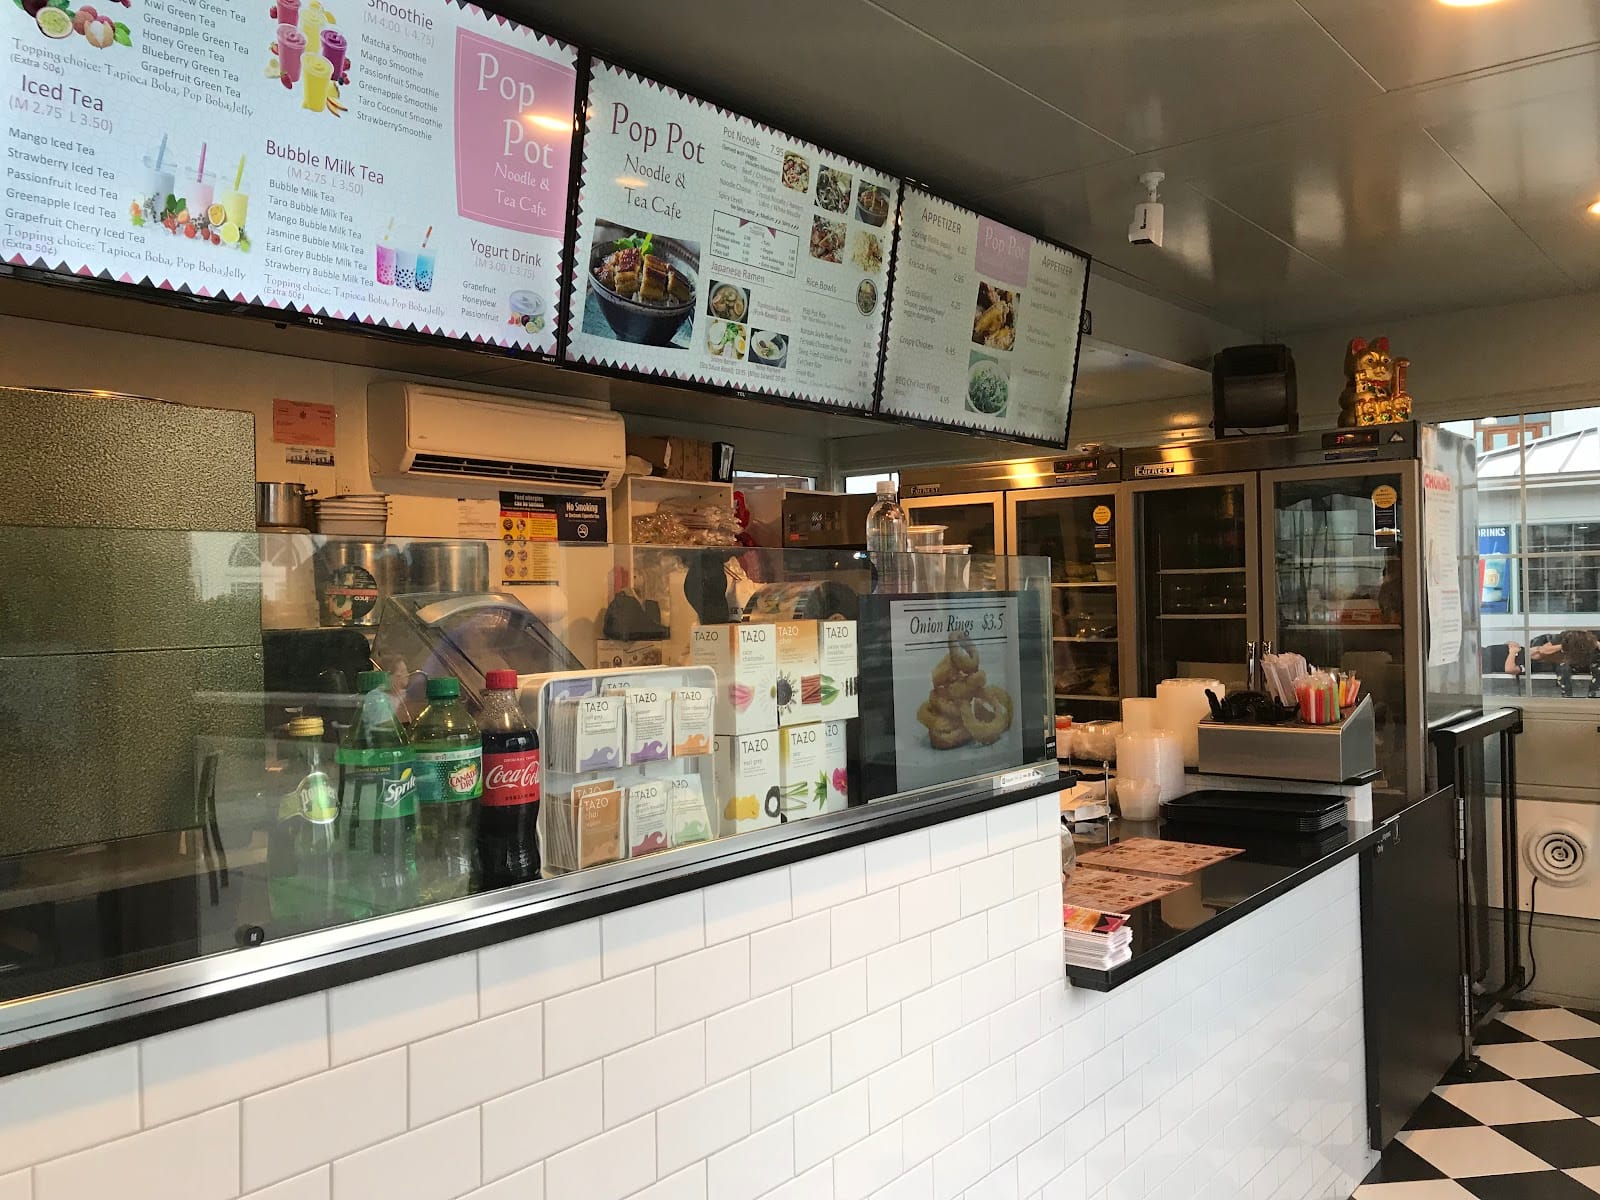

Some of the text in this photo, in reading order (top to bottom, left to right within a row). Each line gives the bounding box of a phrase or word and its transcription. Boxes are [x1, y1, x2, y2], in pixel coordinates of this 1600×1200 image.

[167, 4, 196, 21] Green
[199, 14, 216, 28] Tea
[199, 0, 246, 23] Green Tea
[142, 28, 225, 63] Honey Green Tea
[143, 13, 249, 55] Greenapple Green Tea
[142, 44, 239, 82] Blueberry Green Tea
[361, 33, 427, 65] Matcha Smoothie
[12, 37, 60, 63] Topping
[104, 63, 147, 86] Tapioca
[183, 87, 202, 103] Pop
[360, 49, 424, 79] Mango Smoothie
[22, 74, 103, 112] Iced Tea
[141, 60, 241, 98] Grapefruit Green Tea
[359, 64, 440, 99] Passionfruit Smoothie
[477, 52, 535, 113] Pop
[358, 80, 438, 113] Greenapple Smoothie
[358, 95, 443, 130] Taro Coconut Smoothie
[9, 127, 95, 156] Mango Iced Tea
[503, 119, 553, 169] Pot
[611, 102, 657, 153] Pop
[666, 122, 705, 164] Pot
[8, 147, 115, 180] Strawberry Iced Tea
[266, 139, 384, 184] Bubble Milk Tea
[624, 153, 686, 189] Noodle &
[8, 167, 118, 201] Passionfruit Iced Tea
[269, 179, 335, 203] Bubble Milk Tea
[494, 162, 550, 191] Noodle &
[6, 187, 117, 219] Greenapple Iced Tea
[268, 194, 353, 223] Taro Bubble Milk Tea
[494, 188, 547, 217] Tea Cafe
[624, 186, 682, 220] Tea Cafe
[5, 207, 145, 244] Grapefruit Cherry Iced Tea
[267, 210, 362, 240] Mango Bubble Milk Tea
[4, 223, 54, 245] Topping
[98, 241, 141, 260] Tapioca
[176, 256, 195, 271] Pop
[266, 227, 364, 255] Jasmine Bubble Milk Tea
[470, 238, 542, 268] Yogurt Drink
[266, 243, 368, 271] Earl Grey Bubble Milk Tea
[264, 258, 374, 287] Strawberry Bubble Milk Tea
[307, 316, 324, 325] TCL
[566, 501, 599, 514] No Smoking
[1479, 527, 1506, 537] RINKS
[694, 631, 719, 641] TAZO
[741, 629, 766, 643] TAZO
[778, 626, 799, 637] TAZO
[826, 626, 849, 638] TAZO
[910, 613, 1004, 636] Onion Rings $3.5
[585, 701, 609, 713] TAZO
[634, 692, 657, 704] TAZO
[680, 691, 702, 701] TAZO
[742, 738, 769, 754] TAZO
[791, 730, 816, 746] TAZO
[460, 777, 474, 790] DRY
[636, 787, 658, 800] TAZO
[583, 797, 609, 810] TAZO
